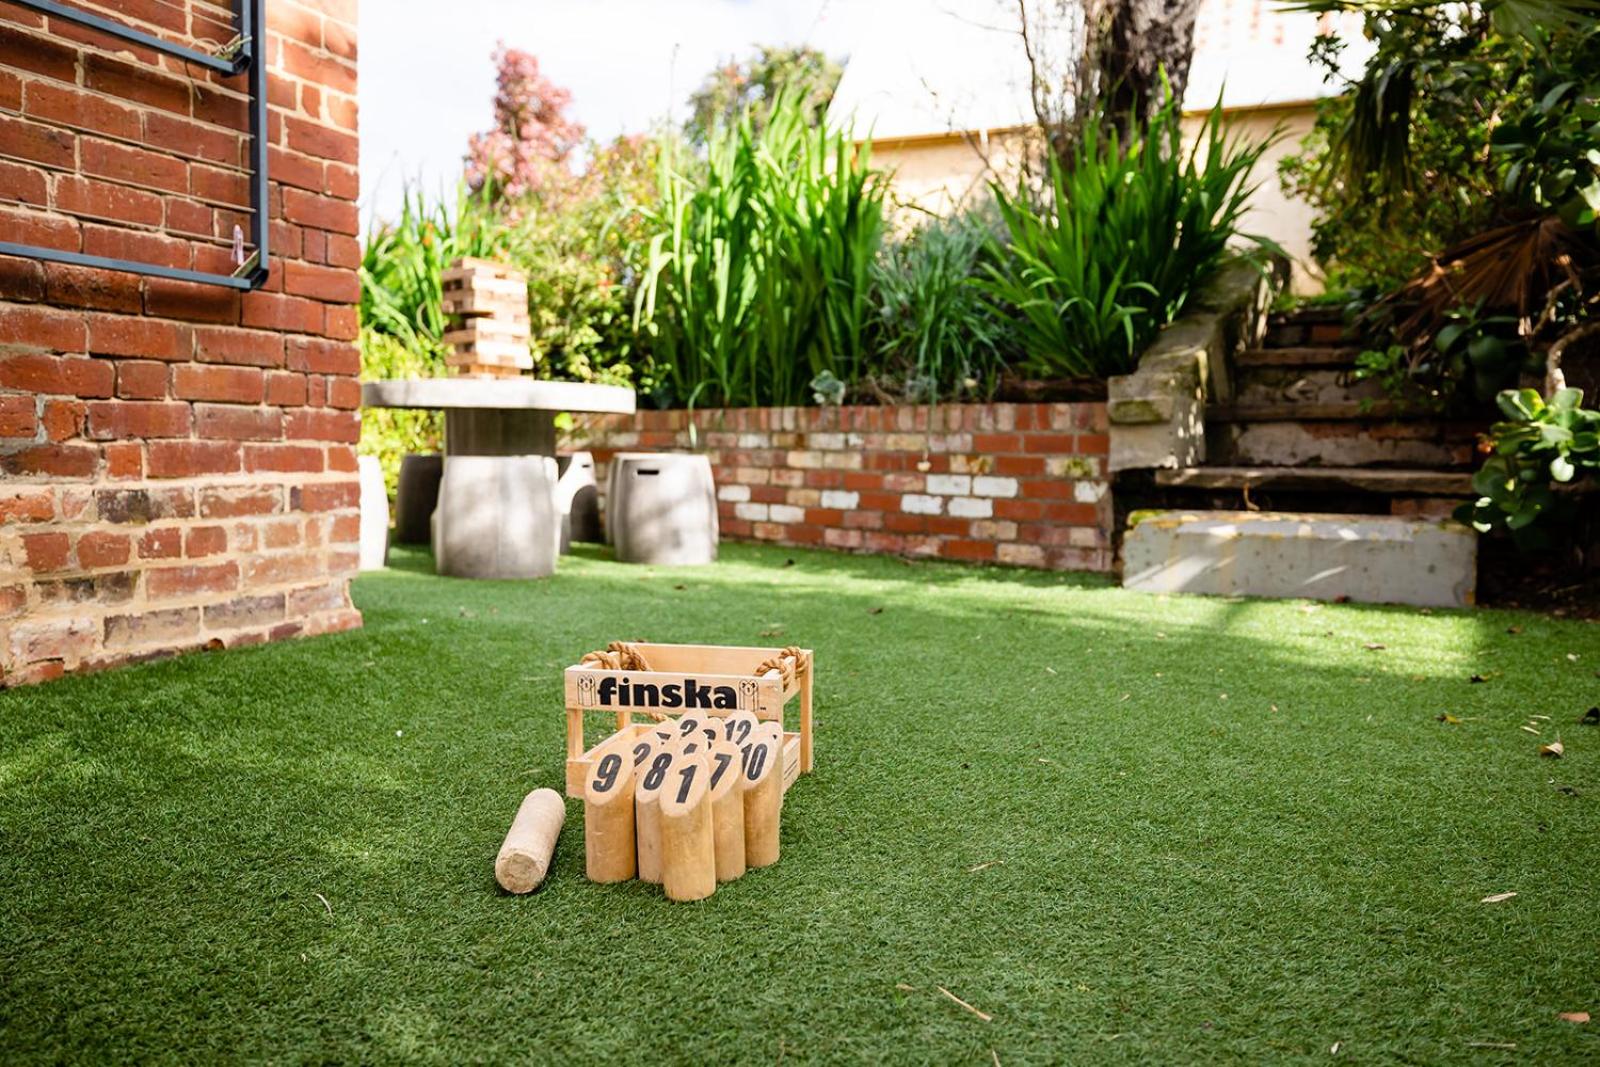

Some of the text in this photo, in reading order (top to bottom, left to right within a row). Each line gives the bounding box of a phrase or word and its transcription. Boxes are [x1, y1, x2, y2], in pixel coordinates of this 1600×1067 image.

[597, 676, 738, 709] finska
[725, 719, 752, 746] 12
[592, 753, 623, 792] 9
[643, 752, 673, 791] 8
[710, 753, 732, 791] 7
[740, 743, 768, 780] 10
[675, 763, 698, 804] 1
